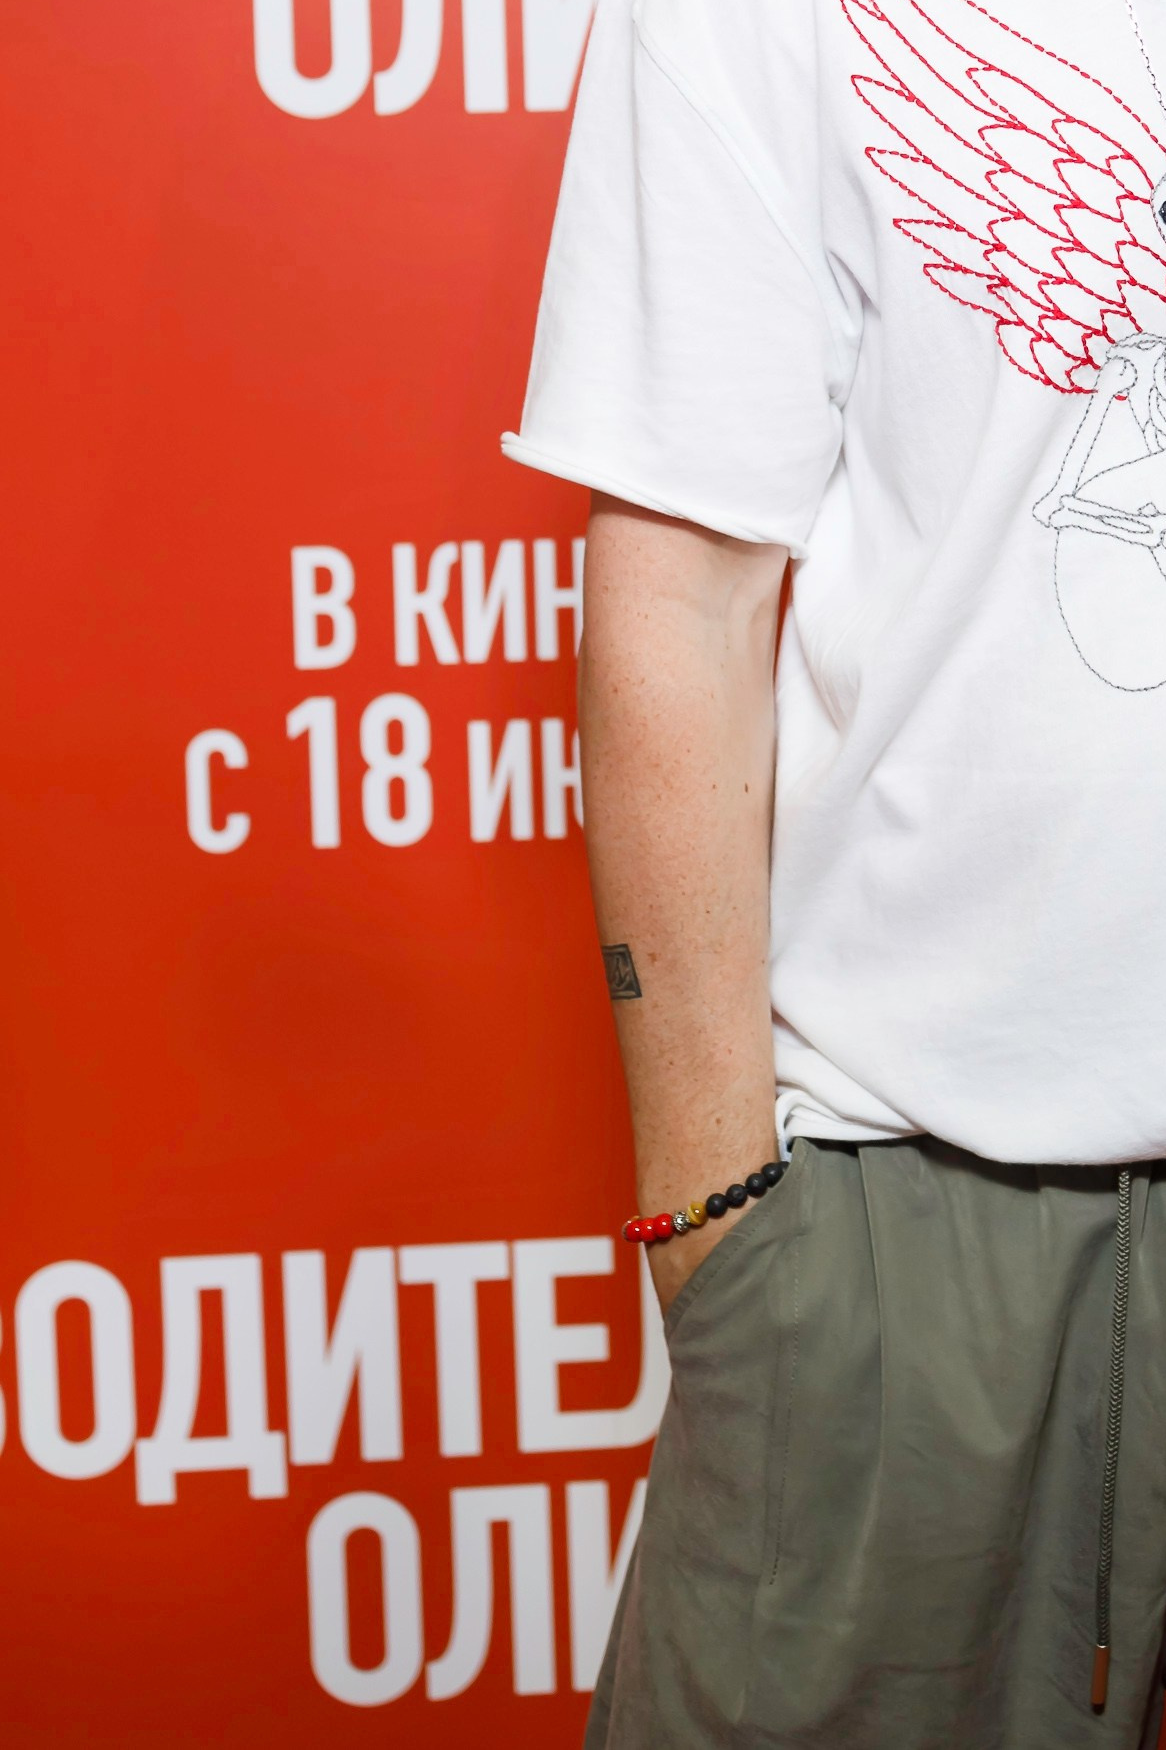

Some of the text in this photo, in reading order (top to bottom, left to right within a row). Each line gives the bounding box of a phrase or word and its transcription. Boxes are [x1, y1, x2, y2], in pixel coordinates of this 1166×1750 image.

[291, 545, 357, 671] В
[286, 692, 433, 850] 18
[0, 1236, 672, 1505] ОДИТЕ
